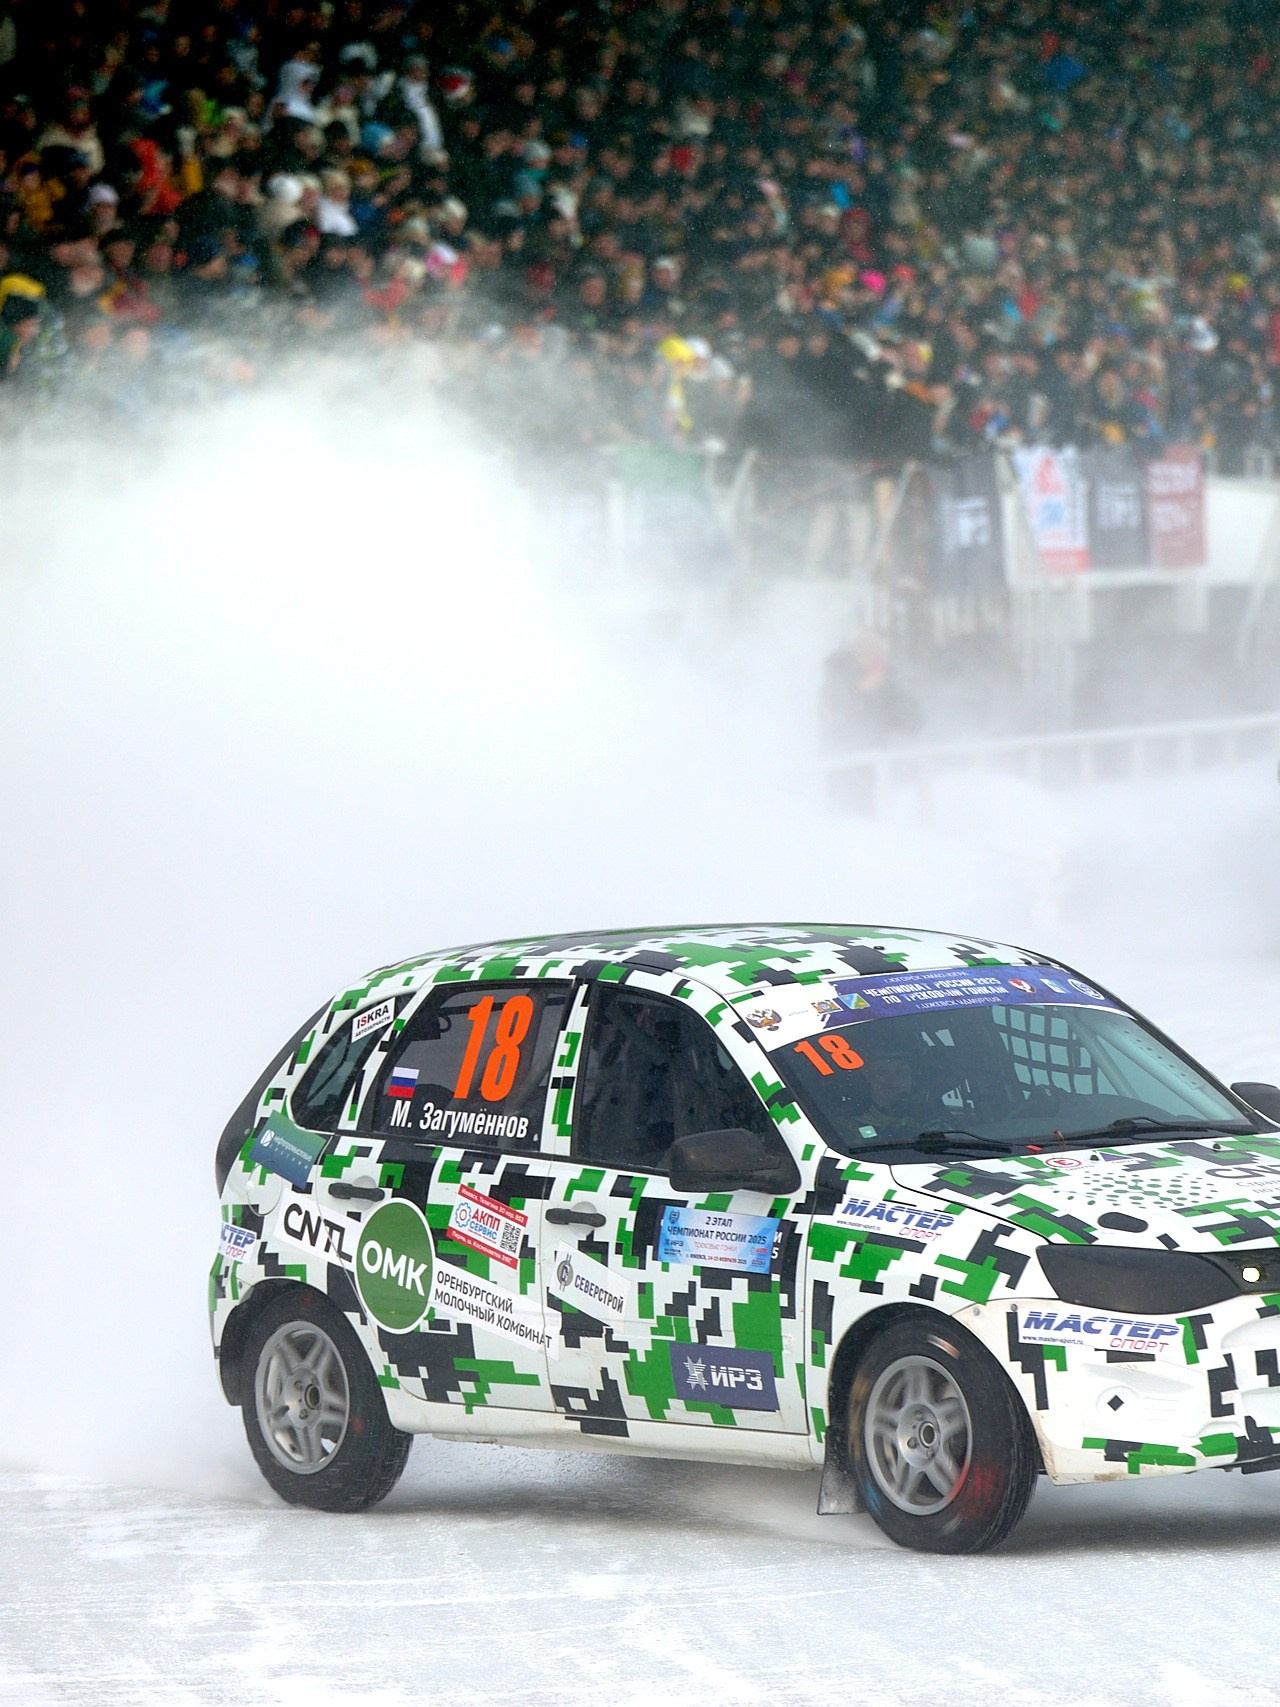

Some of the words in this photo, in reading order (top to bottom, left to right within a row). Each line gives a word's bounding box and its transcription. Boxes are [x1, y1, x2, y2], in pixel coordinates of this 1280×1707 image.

[863, 982, 931, 997] ЧЕМПИОНАТ
[934, 977, 975, 989] РОССИИ
[974, 977, 1002, 986] 2025
[882, 994, 902, 1005] ПО
[902, 987, 964, 1002] ТРЕКОВЫМ
[961, 985, 1010, 996] ГОНКАМ
[357, 1004, 389, 1029] ISKRA
[453, 995, 534, 1102] 18
[793, 1034, 865, 1077] 18
[390, 1100, 412, 1128] М.
[419, 1102, 529, 1138] Загумённов
[472, 1208, 501, 1232] АКПП
[705, 1216, 711, 1226] 2
[712, 1217, 733, 1228] ЭТАП
[842, 1198, 955, 1231] МАСТЕР
[221, 1224, 257, 1249] СТЕР
[284, 1202, 353, 1263] CNTL
[469, 1220, 498, 1240] СЕРВИС
[667, 1226, 714, 1239] ЧЕМПИОНАТ
[715, 1231, 747, 1243] РОССИИ
[747, 1234, 768, 1245] 2025
[898, 1227, 942, 1241] СПОРТ
[361, 1239, 428, 1297] ОМК
[437, 1270, 513, 1314] ОРЕНБУРГСКИЙ
[574, 1274, 624, 1313] СЕВЕРСТРОЙ
[435, 1288, 495, 1323] МОЛОЧНЫЙ
[497, 1314, 552, 1349] КОМБИНАТ
[1023, 1311, 1180, 1340] МАСТЕР
[1110, 1337, 1169, 1353] СПОРТ
[709, 1365, 763, 1391] ИРЗ
